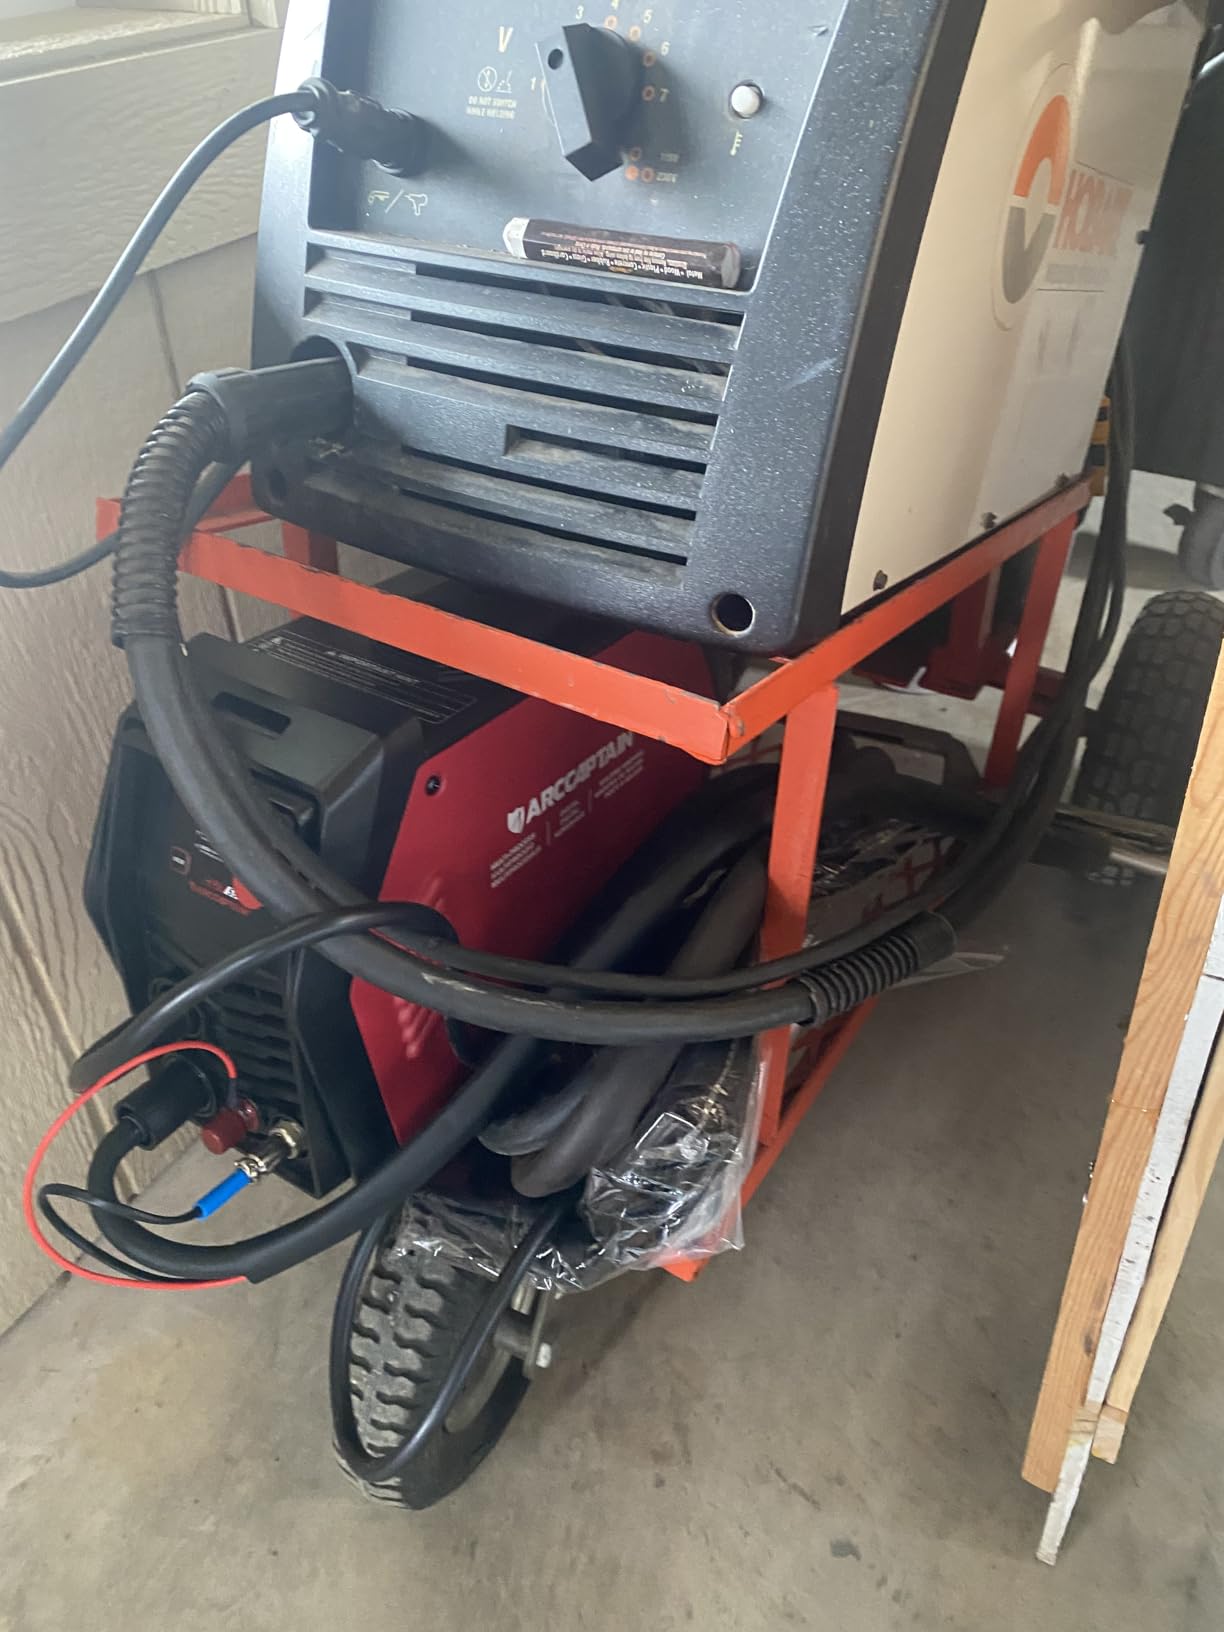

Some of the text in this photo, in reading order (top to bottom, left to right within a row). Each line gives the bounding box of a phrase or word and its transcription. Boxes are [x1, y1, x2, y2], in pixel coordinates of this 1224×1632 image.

[575, 5, 585, 20] 3
[642, 9, 654, 24] 5
[499, 25, 514, 53] V
[660, 41, 670, 56] 6
[659, 87, 669, 102] 7
